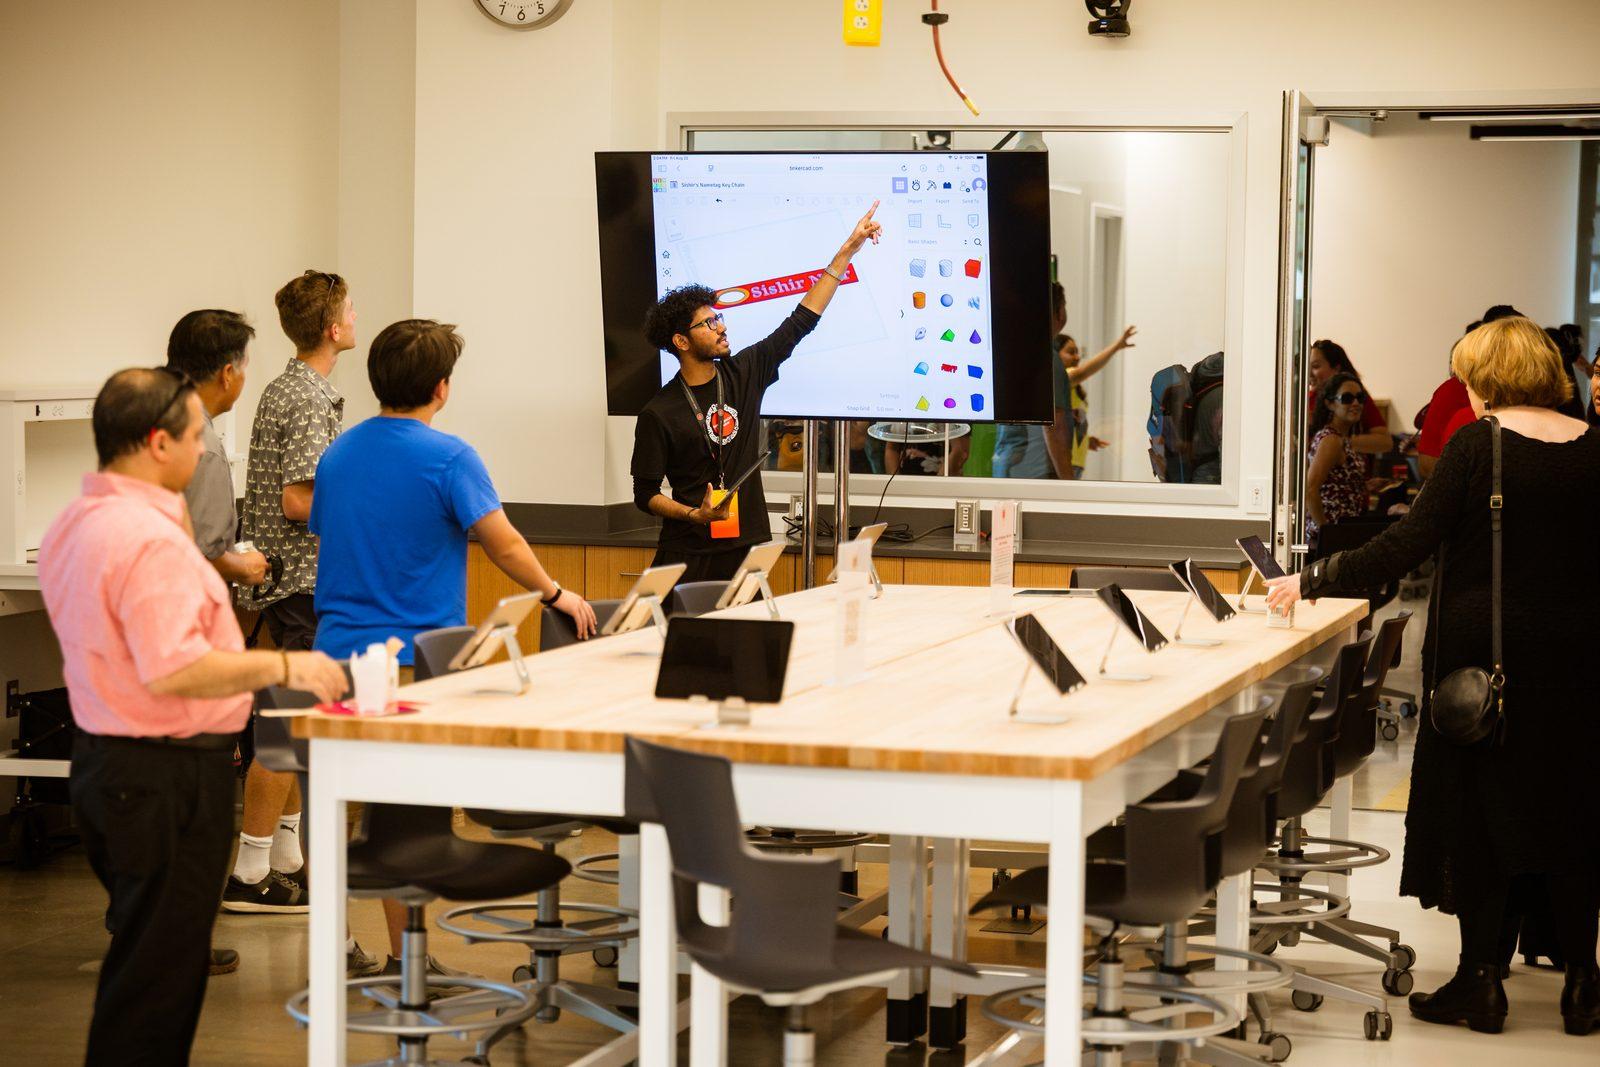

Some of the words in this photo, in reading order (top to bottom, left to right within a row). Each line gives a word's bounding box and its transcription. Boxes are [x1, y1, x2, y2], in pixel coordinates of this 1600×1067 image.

[499, 4, 506, 16] 7
[517, 9, 526, 21] 6
[537, 3, 545, 15] 5
[752, 279, 804, 298] Sishir
